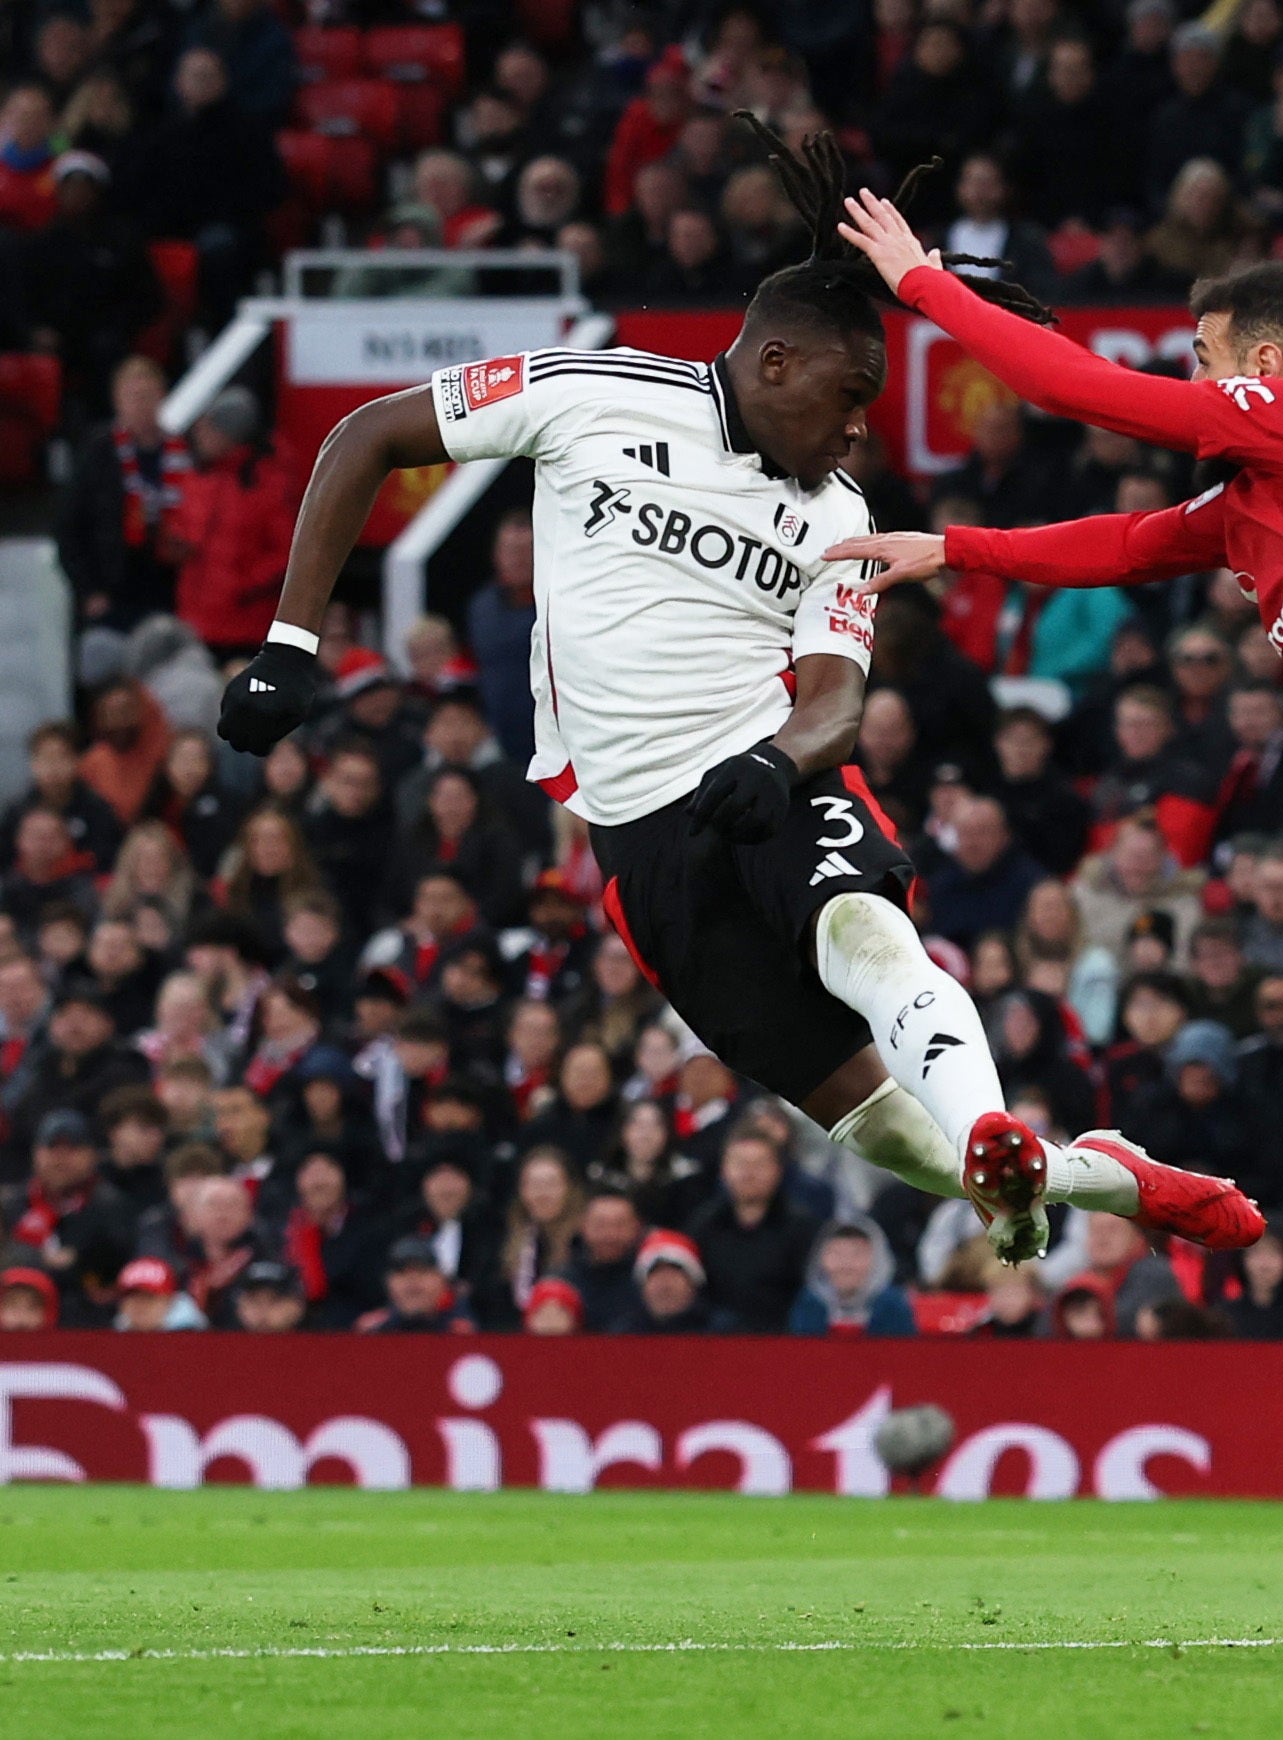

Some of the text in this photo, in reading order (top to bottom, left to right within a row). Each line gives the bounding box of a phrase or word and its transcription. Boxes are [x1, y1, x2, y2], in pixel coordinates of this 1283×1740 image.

[470, 368, 482, 401] FA CUP
[631, 502, 802, 600] SBOTOP
[810, 795, 864, 848] 3
[889, 990, 936, 1051] FFC
